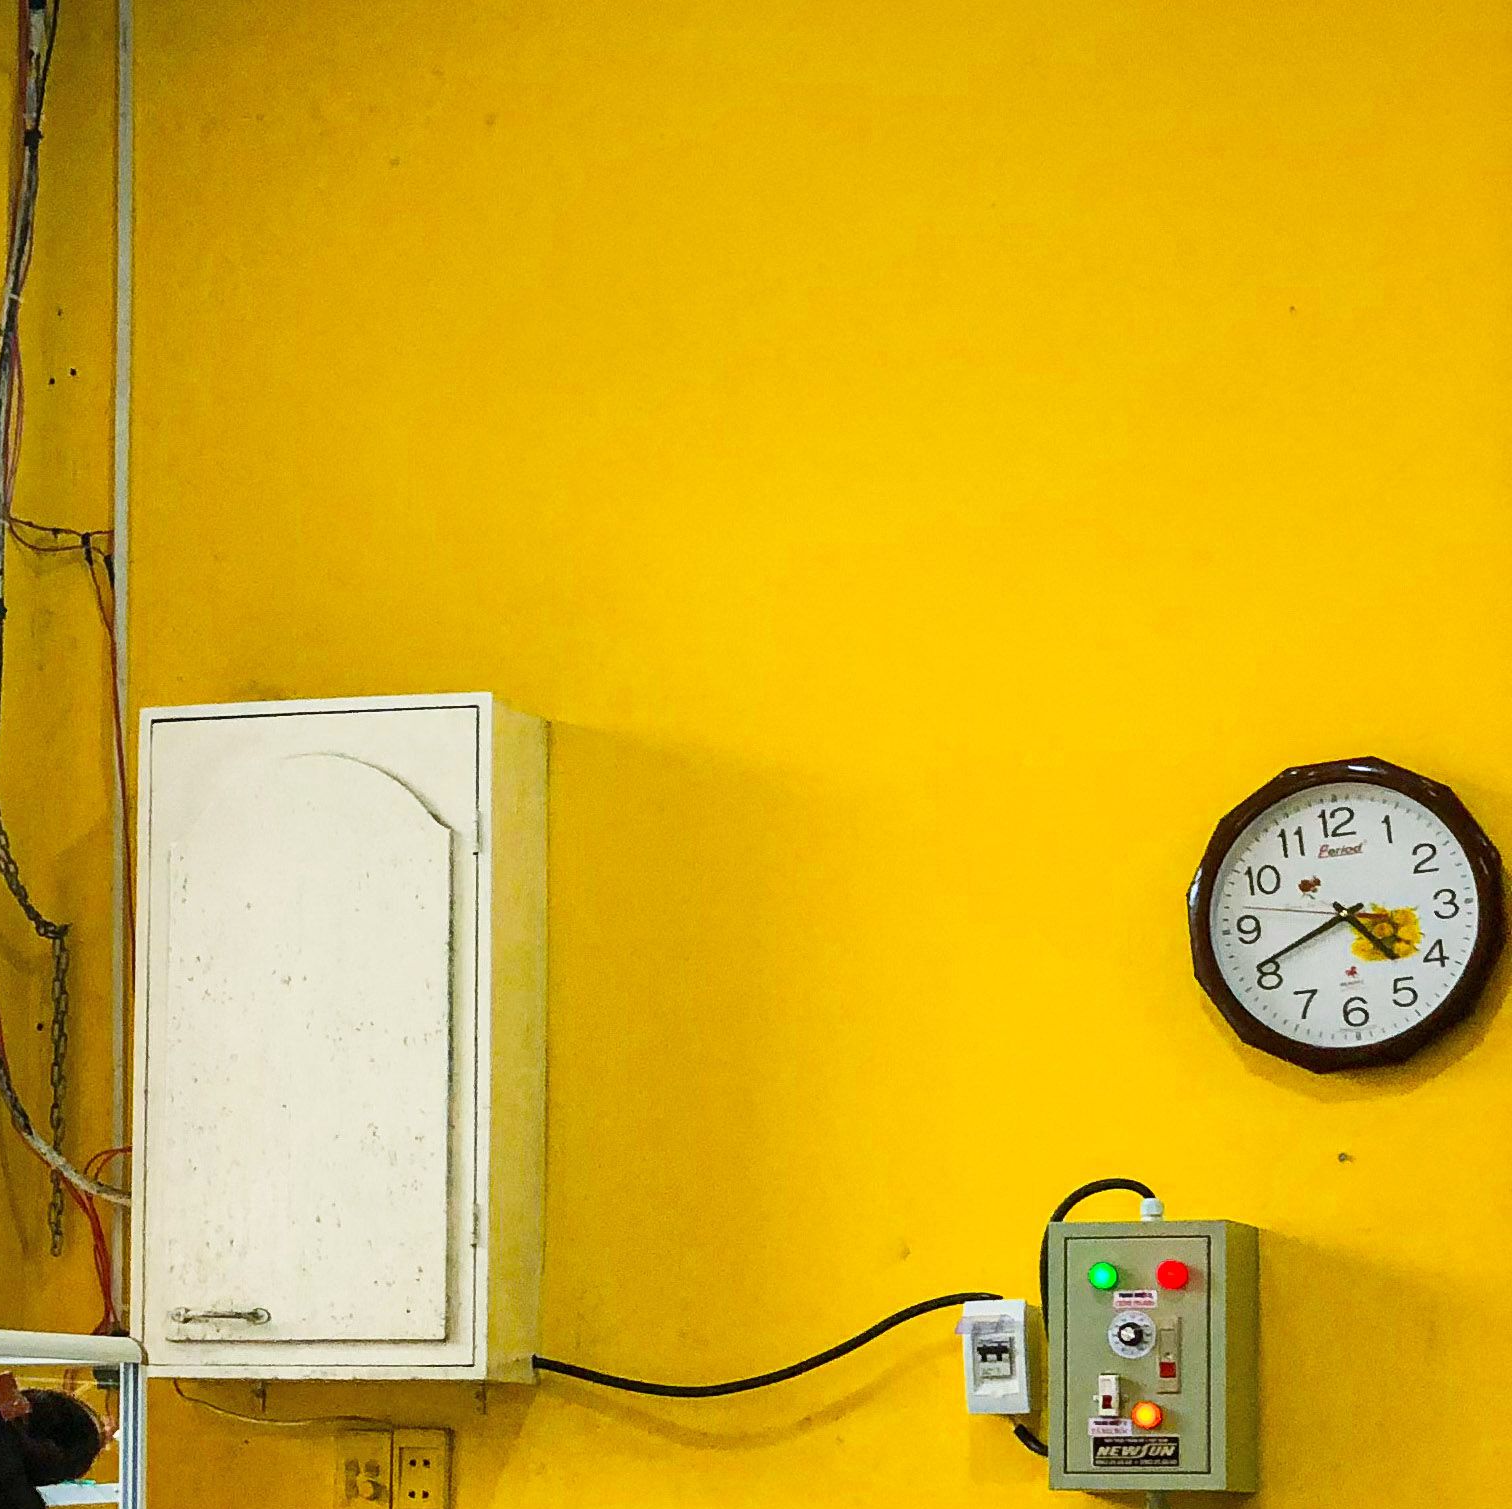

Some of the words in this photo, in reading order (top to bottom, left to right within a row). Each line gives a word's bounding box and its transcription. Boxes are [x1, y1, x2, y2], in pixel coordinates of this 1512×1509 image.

[1318, 806, 1356, 838] 12
[1381, 815, 1393, 844] 1
[1277, 826, 1306, 858] 11
[1412, 843, 1439, 874] 2
[1245, 864, 1281, 896] 10
[1433, 888, 1460, 919] 3
[1236, 915, 1261, 944] 9
[1423, 939, 1449, 969] 4
[1257, 958, 1283, 990] 8
[1293, 988, 1318, 1020] 7
[1393, 976, 1418, 1008] 5
[1343, 996, 1369, 1027] 6
